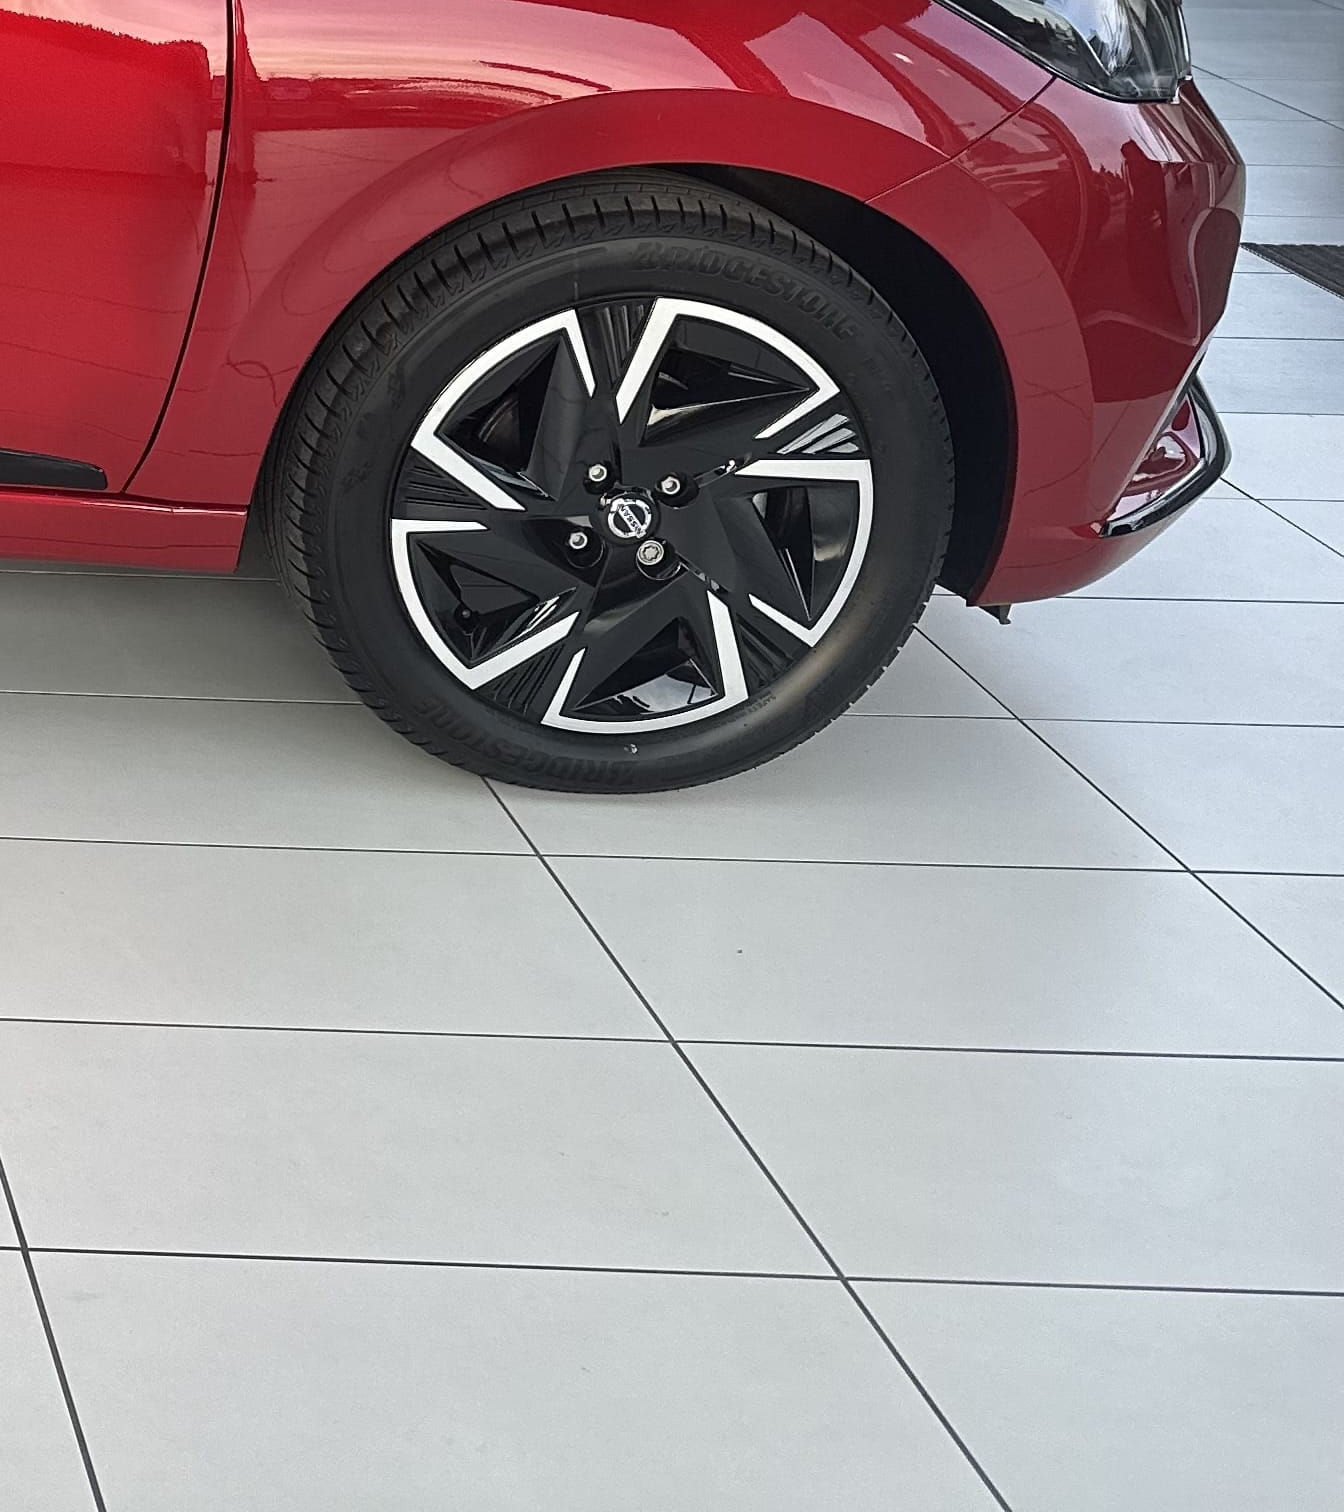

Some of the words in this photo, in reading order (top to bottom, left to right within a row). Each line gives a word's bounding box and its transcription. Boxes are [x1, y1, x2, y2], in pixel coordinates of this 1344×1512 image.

[631, 241, 855, 339] BRIDGESTONE
[616, 503, 644, 535] NISSAN
[412, 697, 635, 786] BRIDGESTONE
